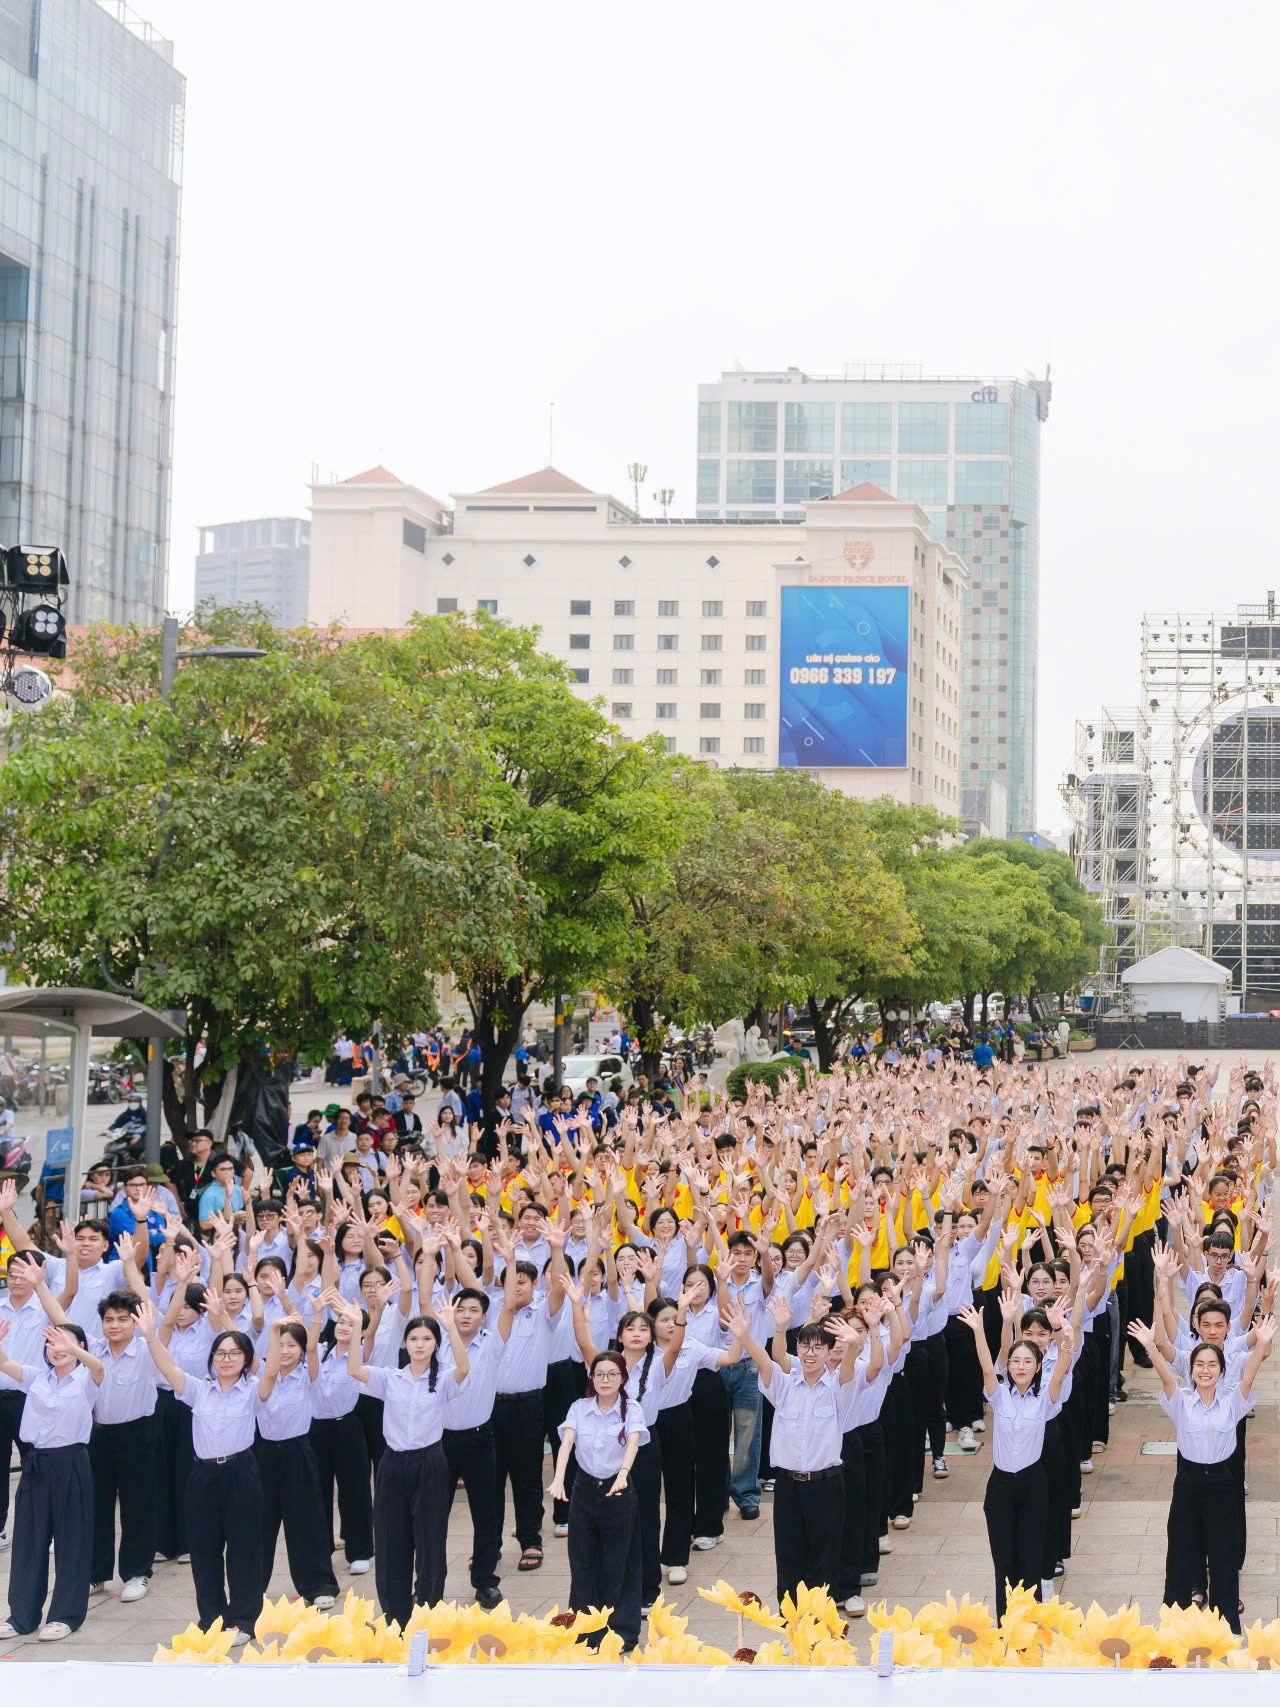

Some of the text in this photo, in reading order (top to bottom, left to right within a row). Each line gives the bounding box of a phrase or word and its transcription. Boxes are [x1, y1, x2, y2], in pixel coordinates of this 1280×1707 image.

[971, 387, 997, 404] citi
[790, 667, 896, 684] 0966 339 197
